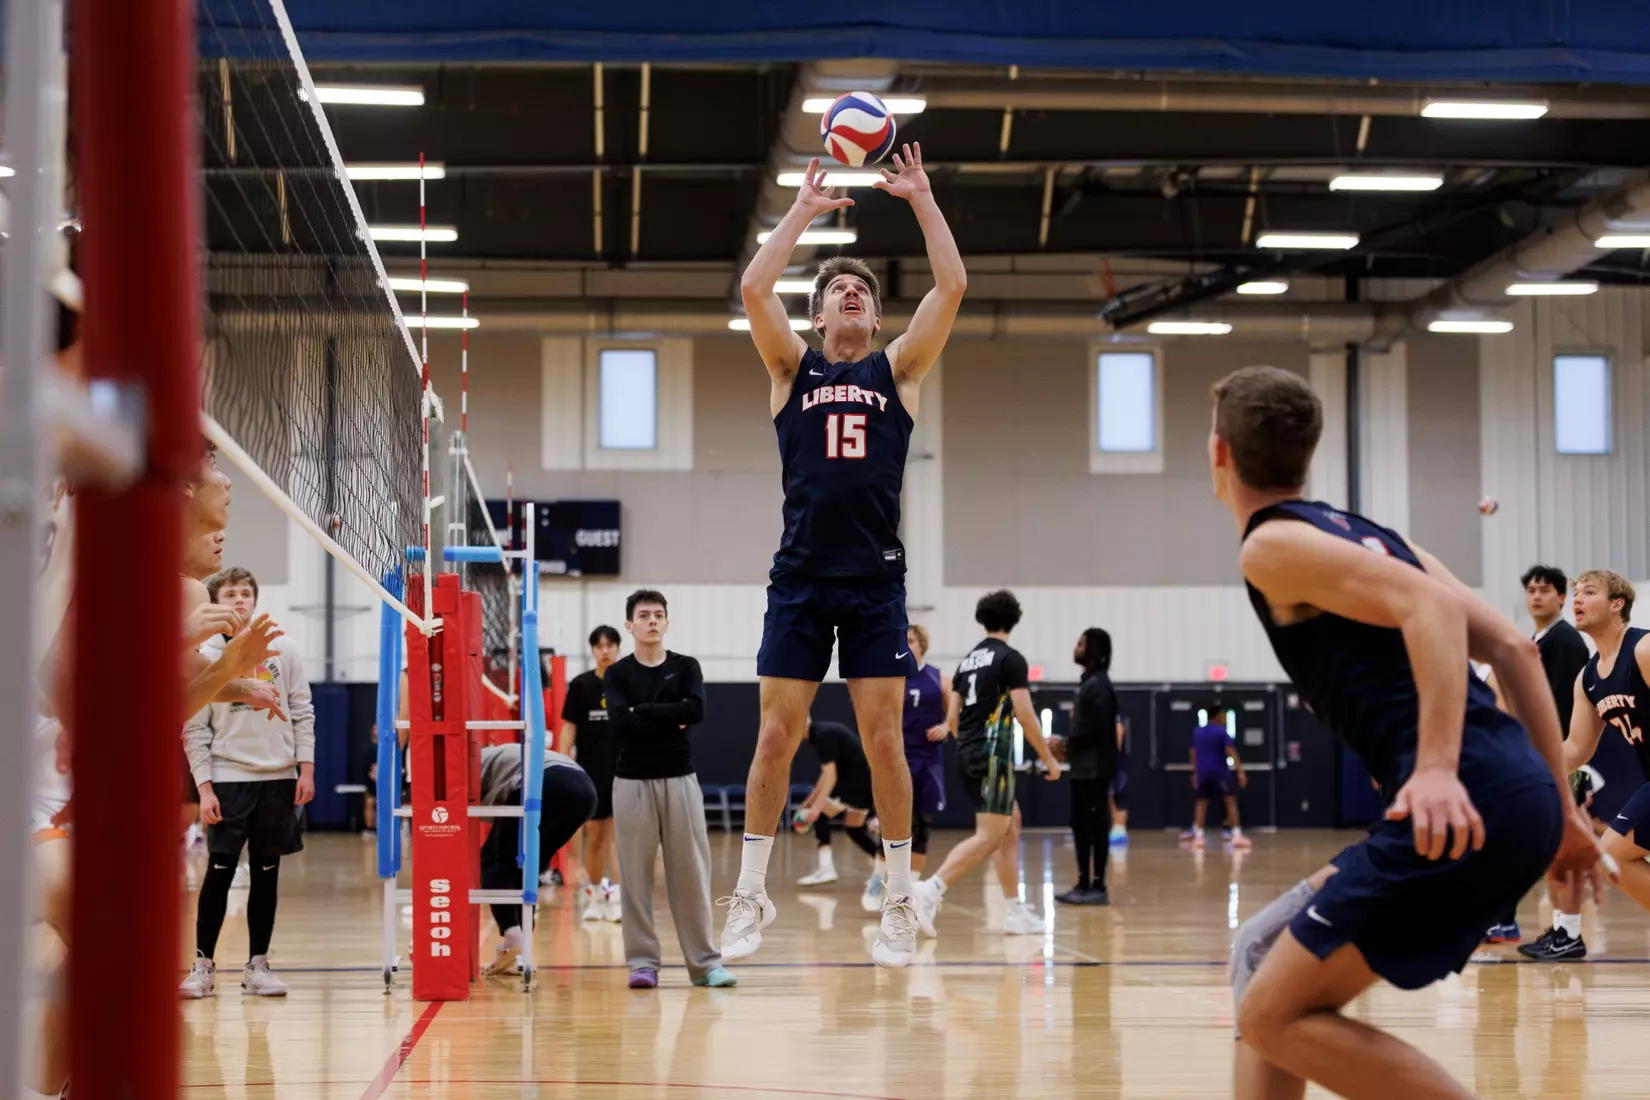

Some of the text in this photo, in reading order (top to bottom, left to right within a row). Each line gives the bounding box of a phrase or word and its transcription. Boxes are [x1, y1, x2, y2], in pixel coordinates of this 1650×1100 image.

[802, 384, 888, 412] LIBERTY
[825, 413, 867, 459] 15
[575, 529, 620, 547] GUEST
[909, 688, 920, 707] 7
[965, 673, 977, 706] 1
[1596, 694, 1636, 719] IBERTY
